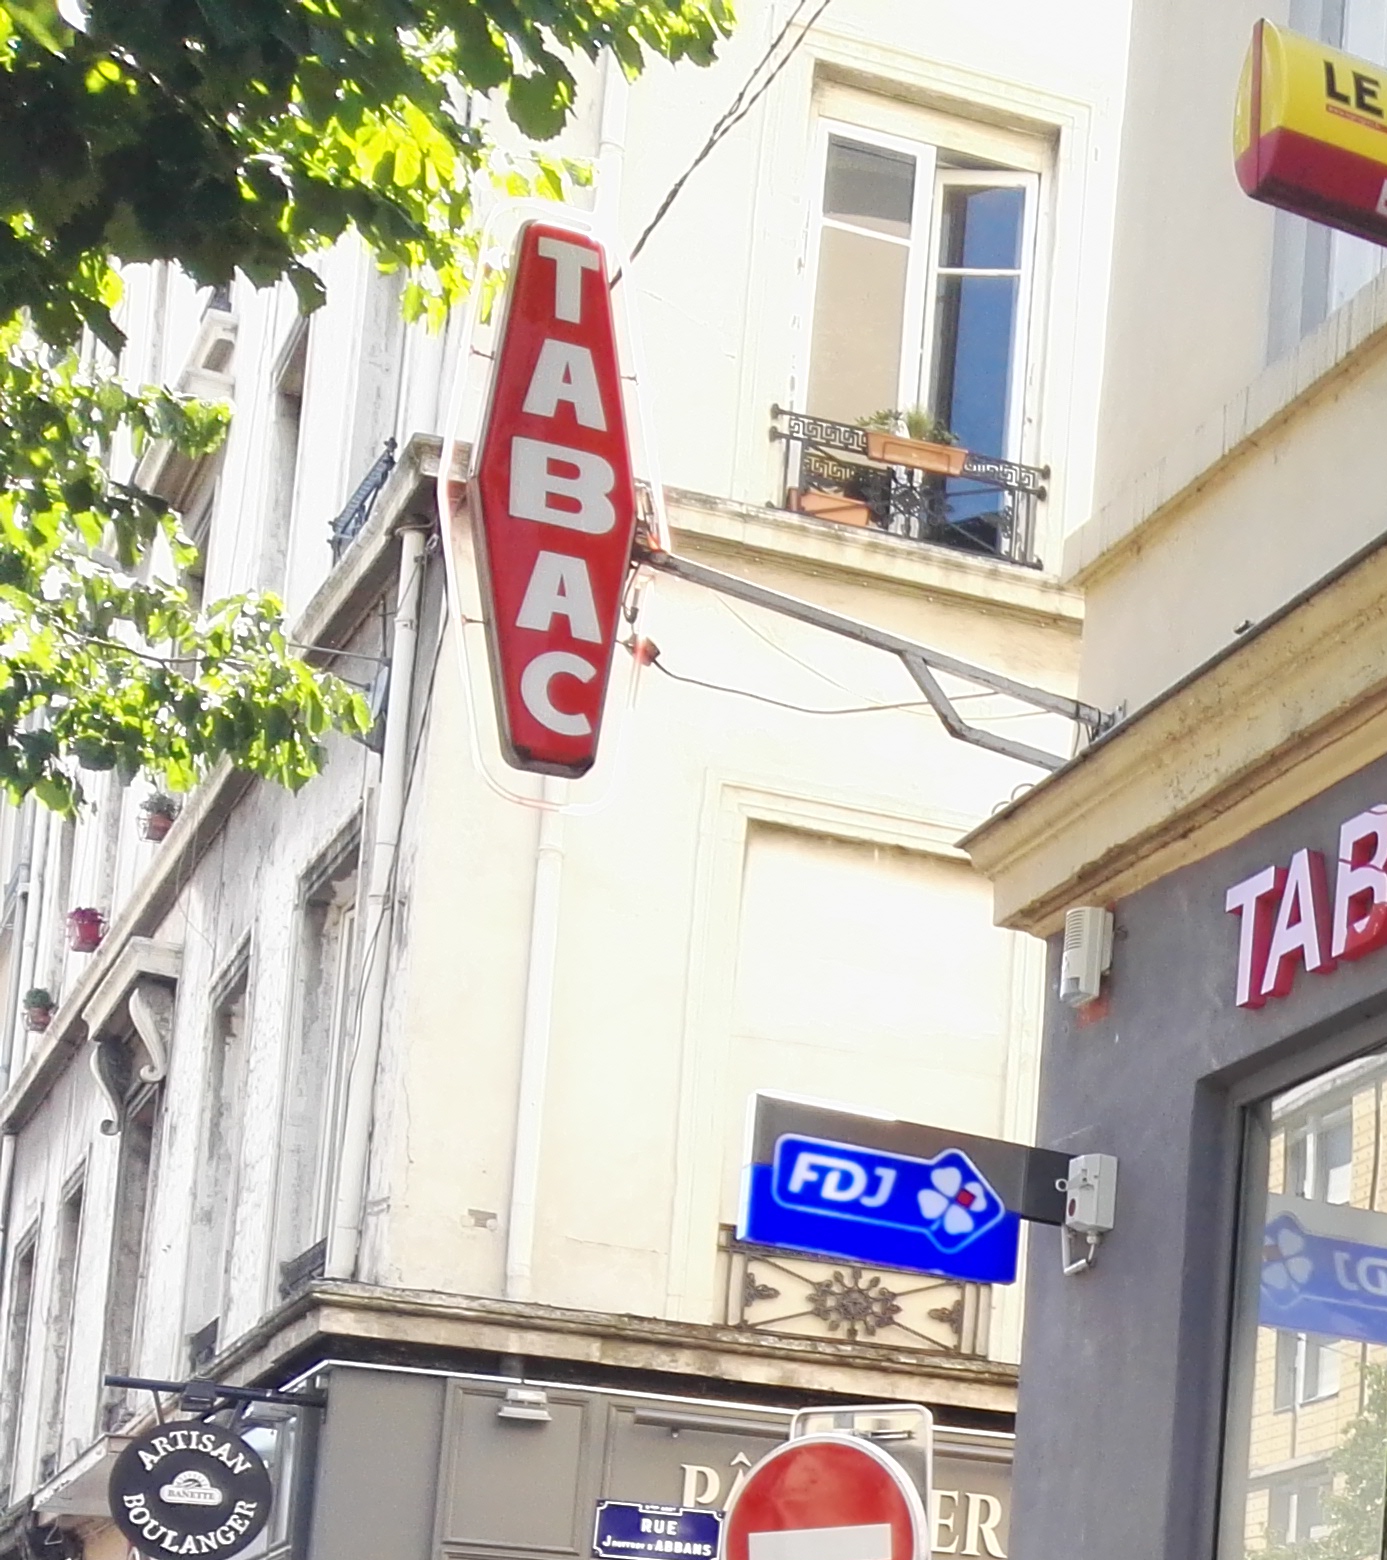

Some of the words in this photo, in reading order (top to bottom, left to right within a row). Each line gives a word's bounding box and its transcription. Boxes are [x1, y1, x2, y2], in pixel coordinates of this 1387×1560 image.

[1324, 60, 1384, 118] LE
[508, 239, 616, 737] TABAC
[787, 1150, 898, 1208] FDJ
[138, 1430, 252, 1475] ARTISAN
[123, 1492, 257, 1554] BOULANGER
[167, 1489, 216, 1501] BANETTE
[641, 1517, 679, 1536] RUE
